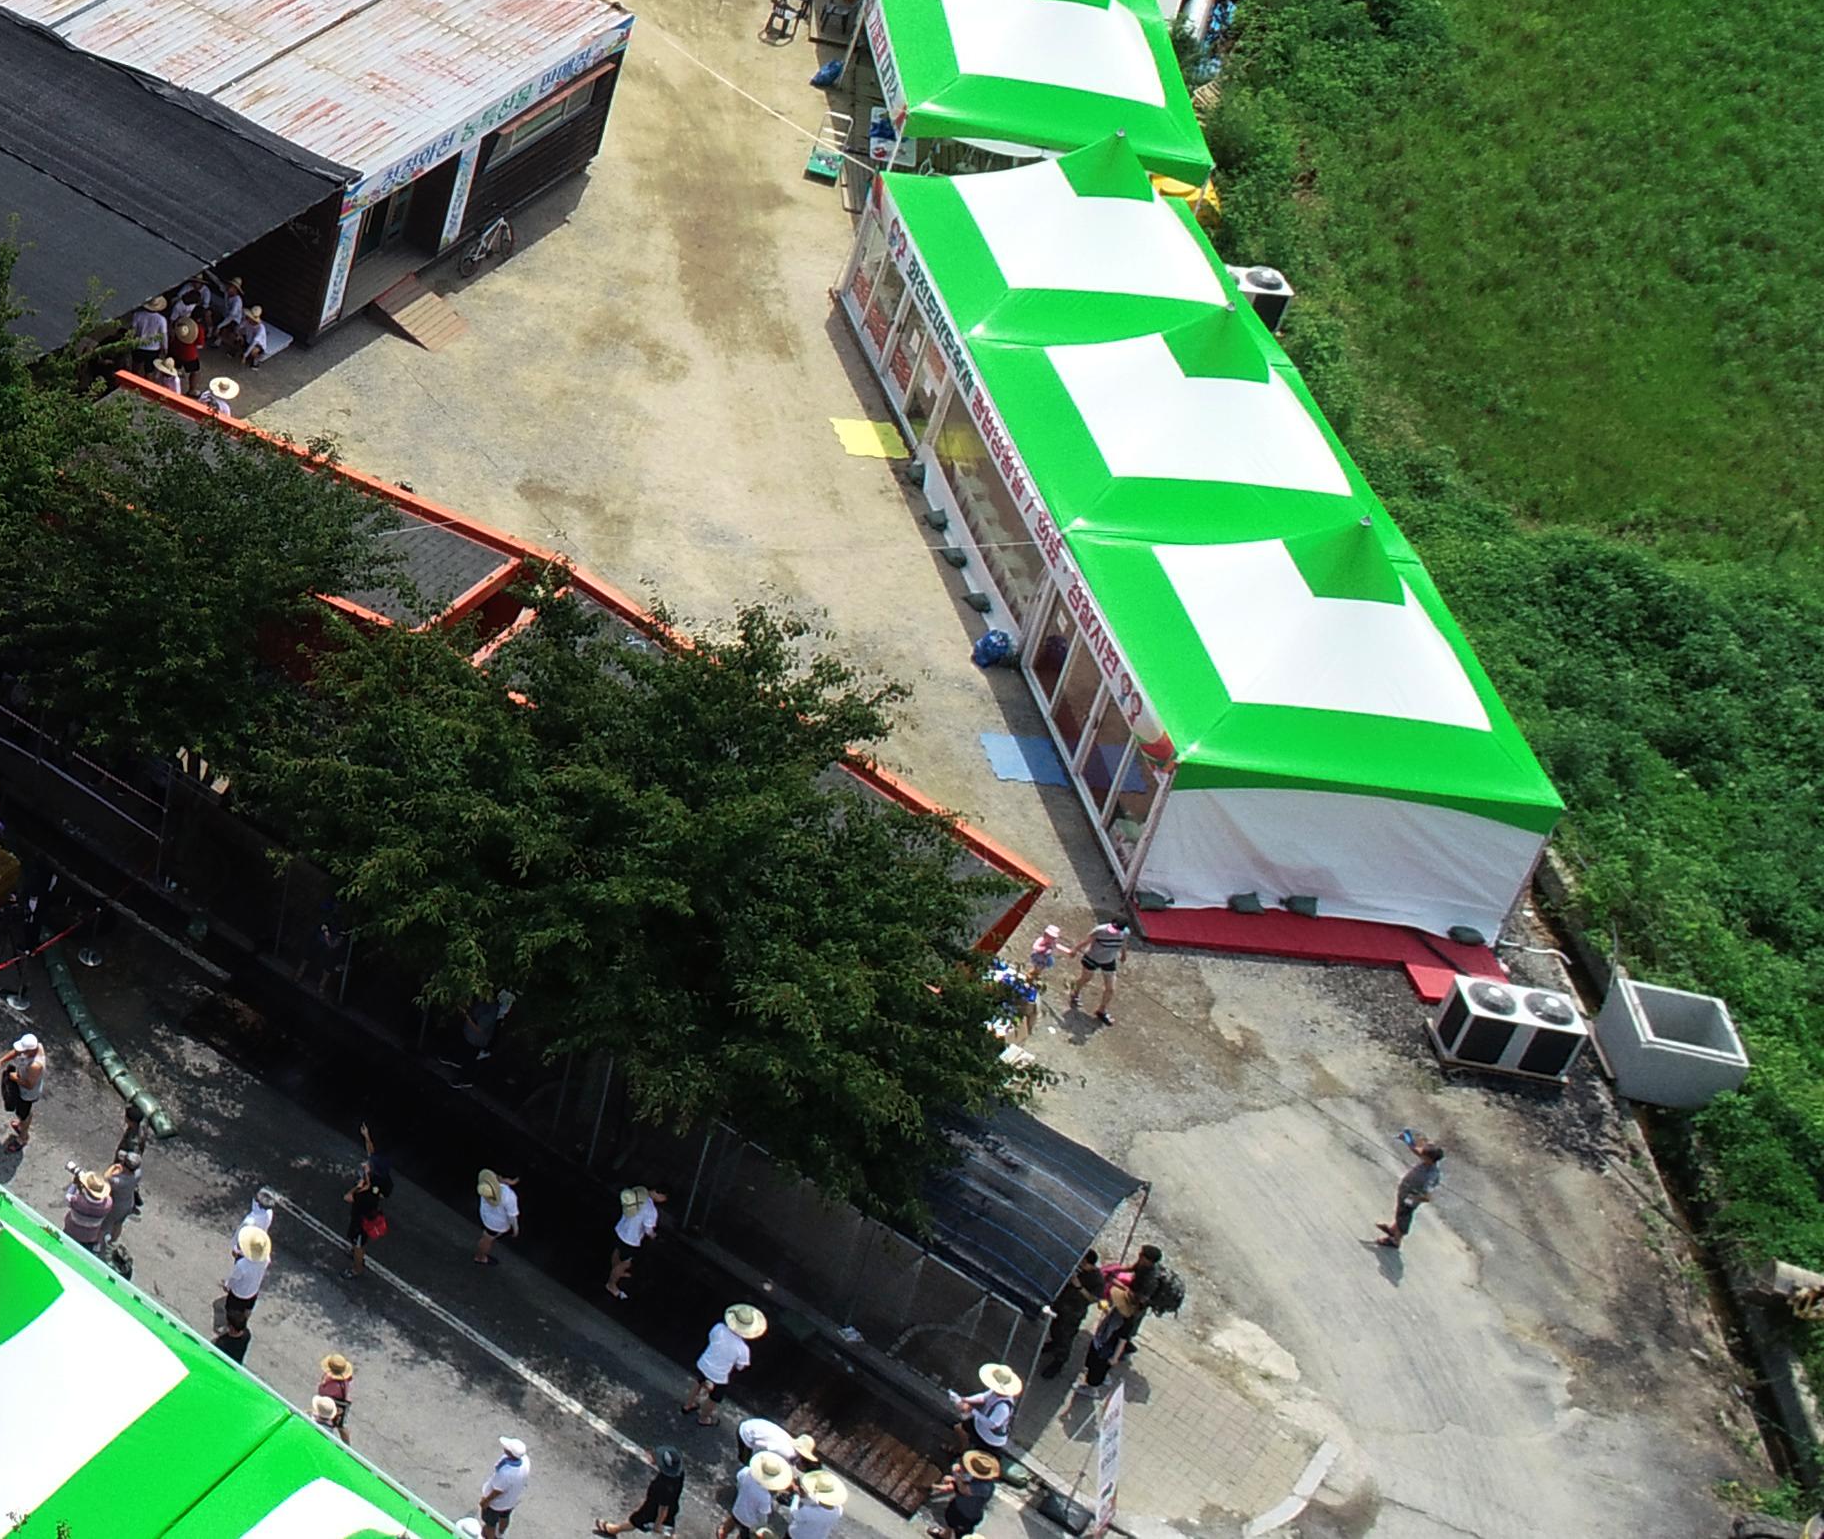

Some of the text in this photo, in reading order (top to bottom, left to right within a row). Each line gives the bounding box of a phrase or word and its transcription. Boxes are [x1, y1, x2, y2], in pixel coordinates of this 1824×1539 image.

[380, 131, 456, 192] 청정화천
[538, 49, 593, 94] 판매장
[904, 252, 976, 398] 화천토마토축제
